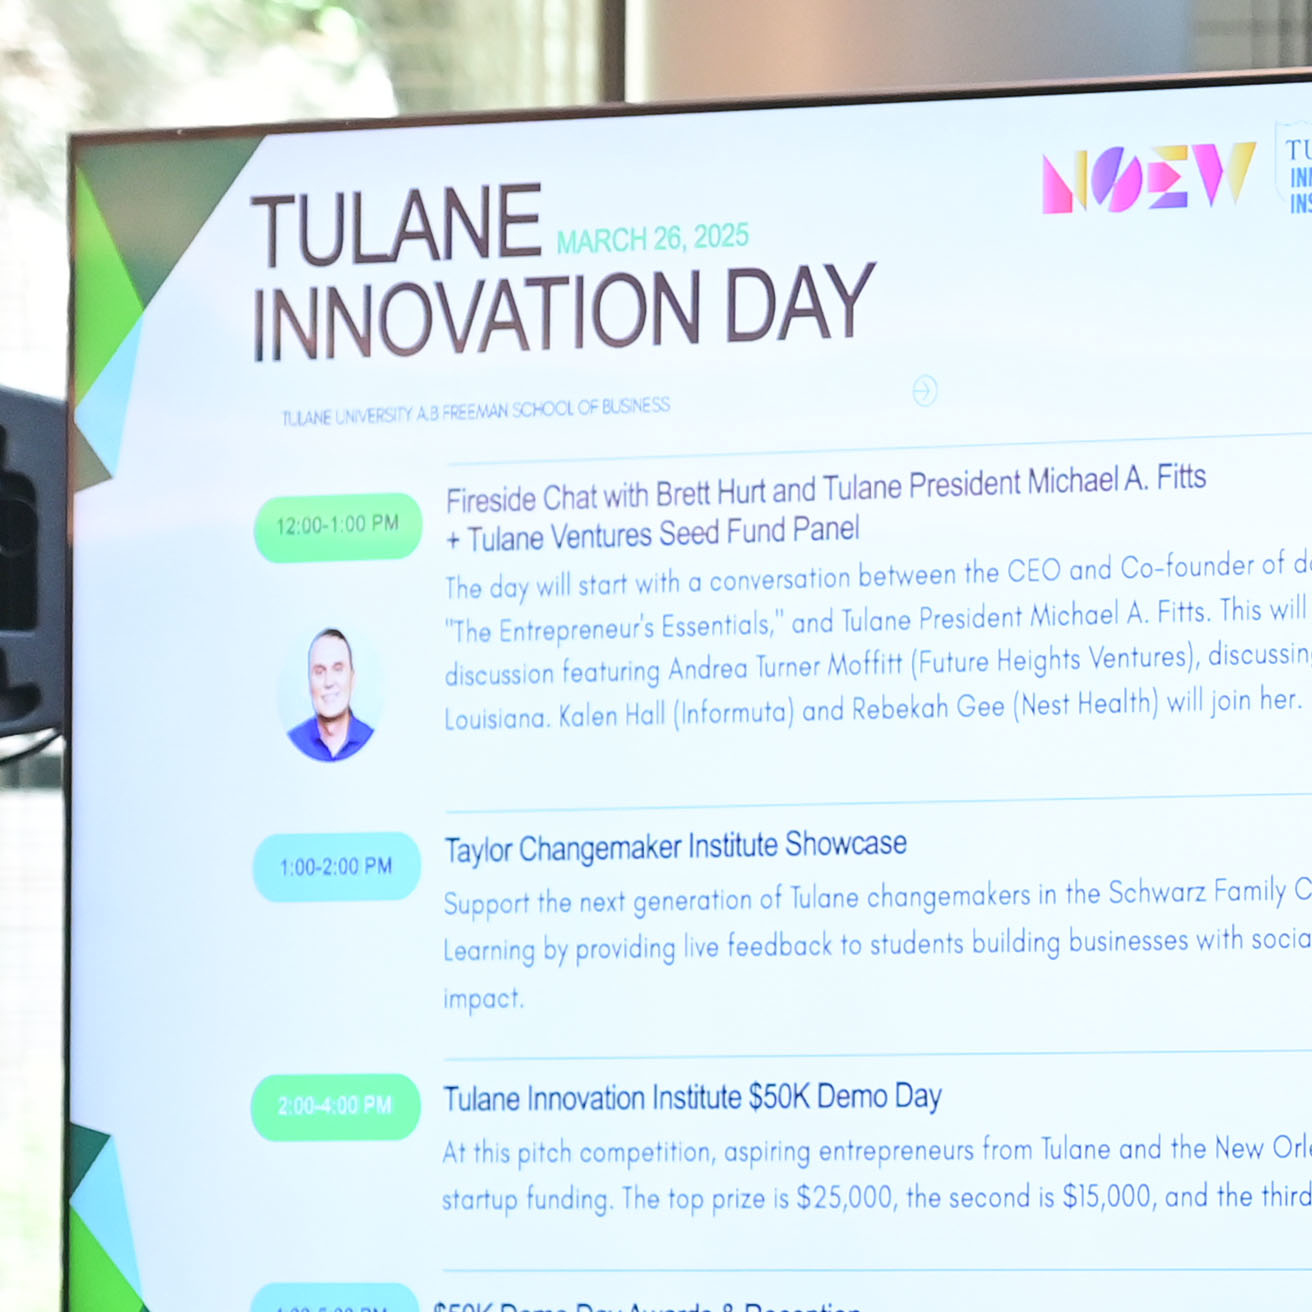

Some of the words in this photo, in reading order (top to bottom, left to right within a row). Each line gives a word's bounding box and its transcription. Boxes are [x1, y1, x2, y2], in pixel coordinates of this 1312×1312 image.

[251, 182, 542, 269] TULANE
[557, 226, 647, 255] MARCH
[654, 224, 687, 253] 26,
[694, 221, 750, 249] 2025
[255, 269, 700, 363] INNOVATION
[727, 262, 877, 343] DAY
[282, 409, 331, 427] TULANE
[336, 405, 413, 425] UNIVERSITY
[416, 404, 439, 422] A.B
[443, 402, 509, 421] FREEMAN
[512, 399, 574, 419] SCHOOL
[578, 397, 599, 417] OF
[602, 396, 671, 416] BUSINESS
[448, 485, 536, 513] Fireside
[544, 484, 597, 511] Chat
[604, 481, 648, 508] with
[657, 480, 710, 507] Brett
[718, 478, 766, 505] Hurt
[773, 475, 815, 504] and
[823, 473, 902, 501] Tulane
[910, 469, 1021, 498] President
[1029, 463, 1118, 494] Michael
[1124, 464, 1148, 491] A.
[1158, 462, 1206, 490] Fitts
[277, 516, 366, 535] 12:00-1:00
[372, 514, 399, 531] PM
[468, 525, 544, 553] Tulane
[551, 523, 652, 550] Ventures
[660, 518, 719, 547] Seed
[728, 516, 785, 544] Fund
[794, 514, 859, 542] Panel
[501, 612, 654, 648] Entrepreneur's
[792, 607, 833, 634] and
[842, 606, 911, 633] Tulane
[920, 602, 1022, 630] President
[1030, 598, 1118, 627] Michael
[1127, 600, 1149, 625] A.
[1159, 599, 1211, 624] Fitts.
[1220, 595, 1262, 622] This
[1270, 593, 1306, 621] will
[446, 707, 550, 731] Louisiana.
[560, 701, 617, 728] Kalen
[626, 698, 665, 726] Hall
[674, 695, 794, 732] (Informuta)
[803, 694, 844, 722] and
[853, 692, 948, 721] Rebekah
[957, 693, 1005, 718] Gee
[1014, 690, 1070, 723] (Nest
[1079, 687, 1158, 720] Health)
[1167, 686, 1202, 713] will
[1210, 689, 1251, 720] join
[1261, 684, 1302, 710] her.
[281, 853, 359, 881] 1:00-2:00
[365, 856, 392, 875] PM
[445, 836, 513, 870] Taylor
[520, 832, 682, 868] Changemaker
[690, 831, 778, 859] Institute
[786, 829, 907, 857] Showcase
[445, 890, 530, 922] Support
[538, 888, 572, 913] the
[581, 891, 626, 913] next
[634, 889, 752, 920] generation
[760, 882, 782, 910] of
[791, 882, 859, 910] Tulane
[868, 879, 1030, 915] changemakers
[1040, 883, 1056, 905] in
[1066, 878, 1101, 905] the
[1109, 876, 1207, 905] Schwarz
[1215, 874, 1286, 910] Family
[444, 987, 524, 1017] impact.
[278, 1095, 359, 1116] 2:00-4:00
[364, 1095, 392, 1115] PM
[443, 1085, 520, 1112] Tulane
[529, 1084, 645, 1111] Innovation
[654, 1082, 742, 1111] Institute
[749, 1080, 810, 1112] $50K
[818, 1081, 888, 1109] Demo
[896, 1081, 942, 1116] Day
[443, 1140, 466, 1163] At
[474, 1137, 510, 1164] this
[518, 1138, 571, 1171] pitch
[580, 1141, 716, 1171] competition,
[725, 1145, 810, 1170] aspiring
[819, 1140, 974, 1169] entrepreneurs
[983, 1133, 1032, 1161] from
[1041, 1134, 1110, 1161] Tulane
[1120, 1133, 1161, 1160] and
[1171, 1133, 1206, 1160] the
[1216, 1134, 1264, 1160] New
[443, 1189, 518, 1218] startup
[527, 1183, 614, 1218] funding.
[622, 1184, 660, 1209] The
[669, 1188, 704, 1217] top
[713, 1188, 765, 1217] prize
[775, 1192, 789, 1210] is
[797, 1183, 898, 1213] $25,000,
[907, 1182, 941, 1208] the
[950, 1182, 1030, 1209] second
[1040, 1187, 1054, 1208] is
[1063, 1181, 1157, 1212] $15,000,
[1165, 1181, 1208, 1208] and
[1217, 1181, 1253, 1208] the
[1262, 1179, 1312, 1207] third
